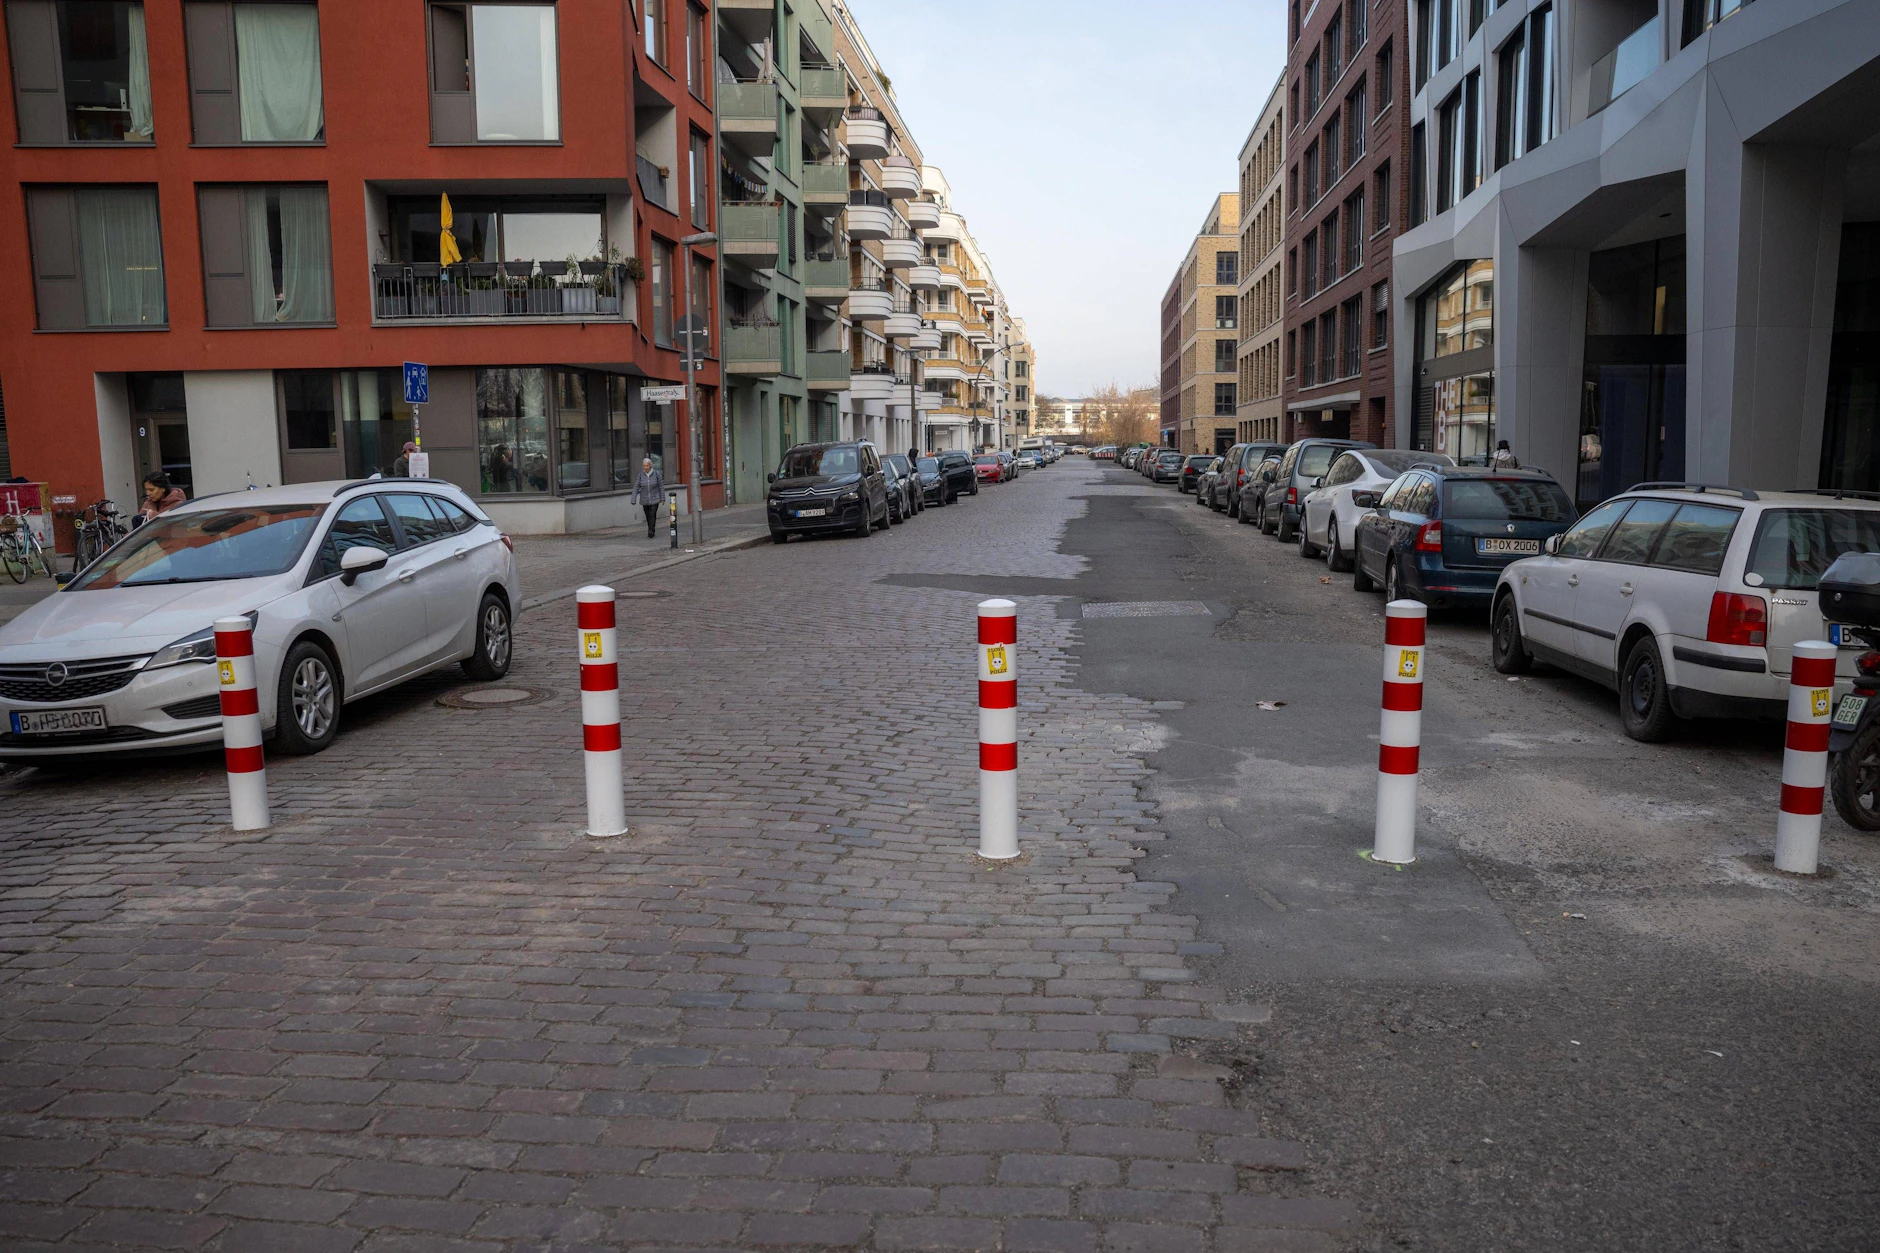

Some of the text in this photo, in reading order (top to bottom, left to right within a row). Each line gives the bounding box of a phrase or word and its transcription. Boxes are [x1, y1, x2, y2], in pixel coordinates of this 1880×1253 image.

[1434, 378, 1456, 412] THE
[139, 426, 146, 437] 9
[1437, 410, 1446, 450] B
[1485, 539, 1538, 551] B OX 2006
[1842, 627, 1852, 643] B
[1841, 697, 1864, 711] 508
[20, 715, 31, 731] B
[1836, 709, 1858, 723] GER
